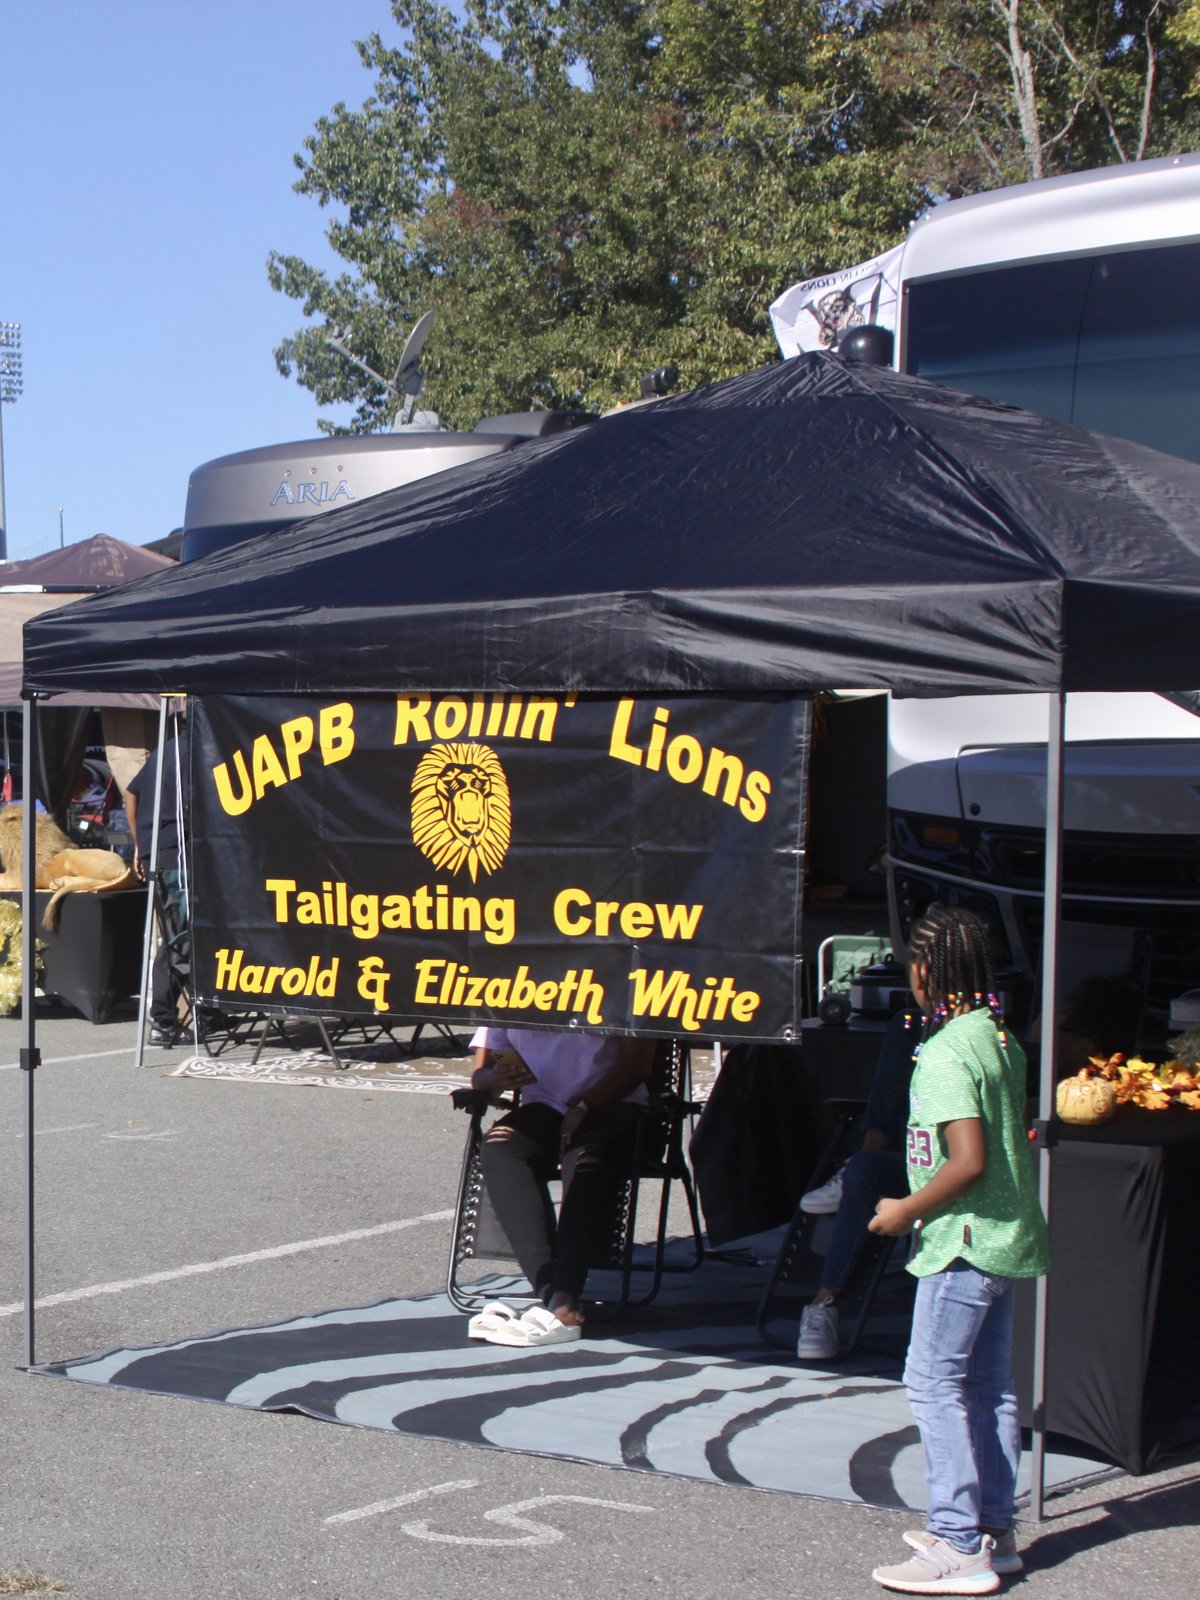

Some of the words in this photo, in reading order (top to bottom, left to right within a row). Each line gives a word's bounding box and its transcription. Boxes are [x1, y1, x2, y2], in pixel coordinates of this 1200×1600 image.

[270, 480, 355, 506] ARIA
[213, 701, 356, 818] UAPB
[608, 696, 772, 824] Lions
[265, 878, 516, 947] Tailgating
[552, 887, 705, 941] Crew
[213, 948, 341, 999] Harold
[355, 955, 392, 1014] &
[413, 957, 606, 1027] Elizabeth
[626, 967, 762, 1033] White
[906, 1126, 935, 1169] 23
